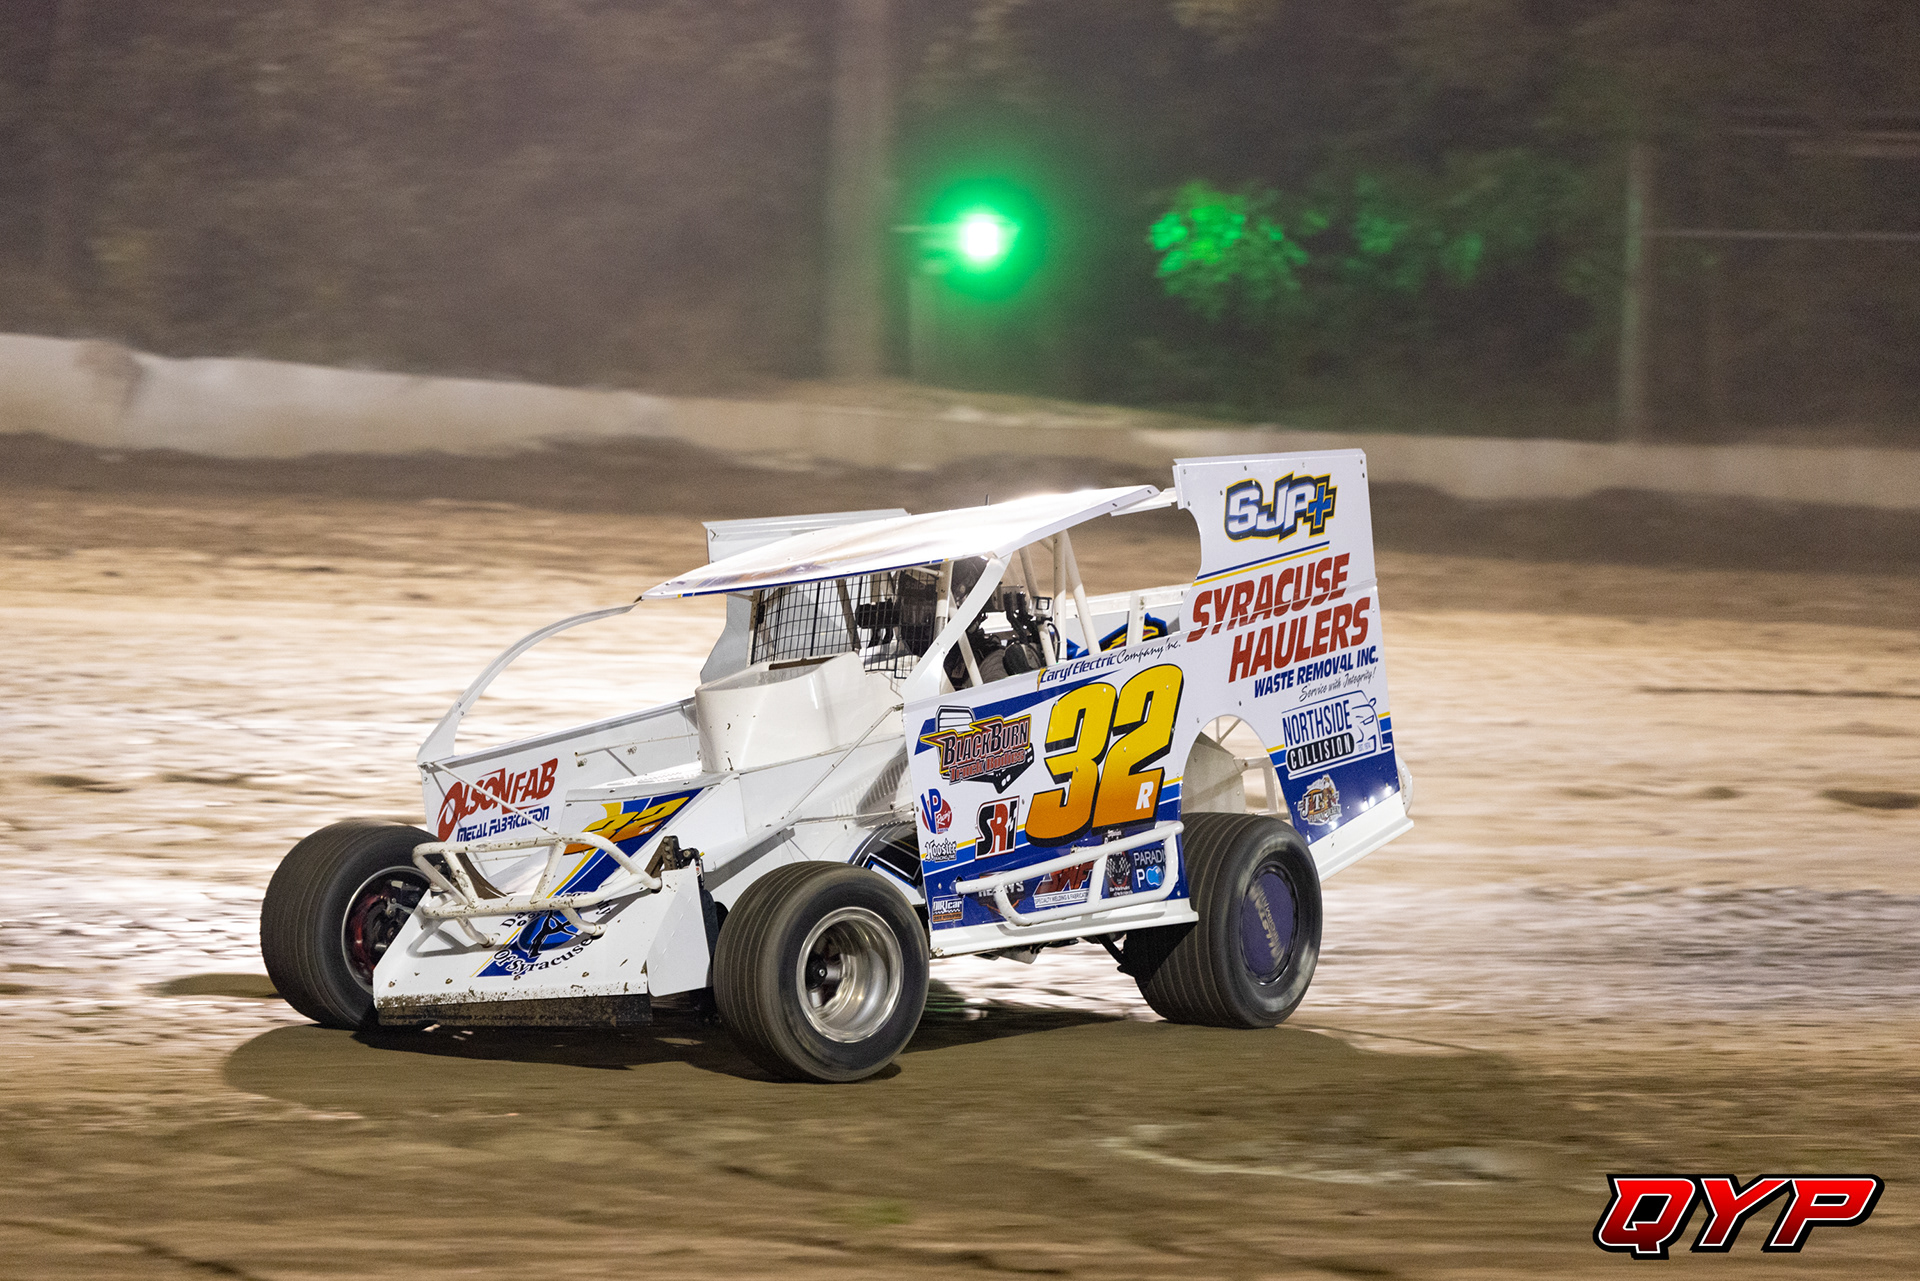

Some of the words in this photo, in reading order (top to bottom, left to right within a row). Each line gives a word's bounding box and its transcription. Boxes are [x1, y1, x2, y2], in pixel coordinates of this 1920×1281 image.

[1187, 552, 1350, 643] SYRACUSE
[1228, 597, 1371, 684] HAULERS
[1072, 654, 1117, 676] Electric
[1117, 647, 1165, 664] Company
[1254, 669, 1295, 698] WASTE
[1296, 652, 1354, 686] REMOVAL
[1356, 645, 1379, 668] INC.
[1299, 683, 1328, 702] Service
[1328, 677, 1342, 692] with
[1282, 699, 1353, 748] NORTHSIDE
[951, 761, 984, 782] Truck
[986, 749, 1025, 771] Bodies
[1025, 663, 1184, 847] 32
[1288, 733, 1352, 771] COLLISION
[920, 788, 942, 834] VP
[1136, 781, 1154, 810] R
[456, 822, 488, 842] METAL
[505, 938, 594, 977] Syracuse
